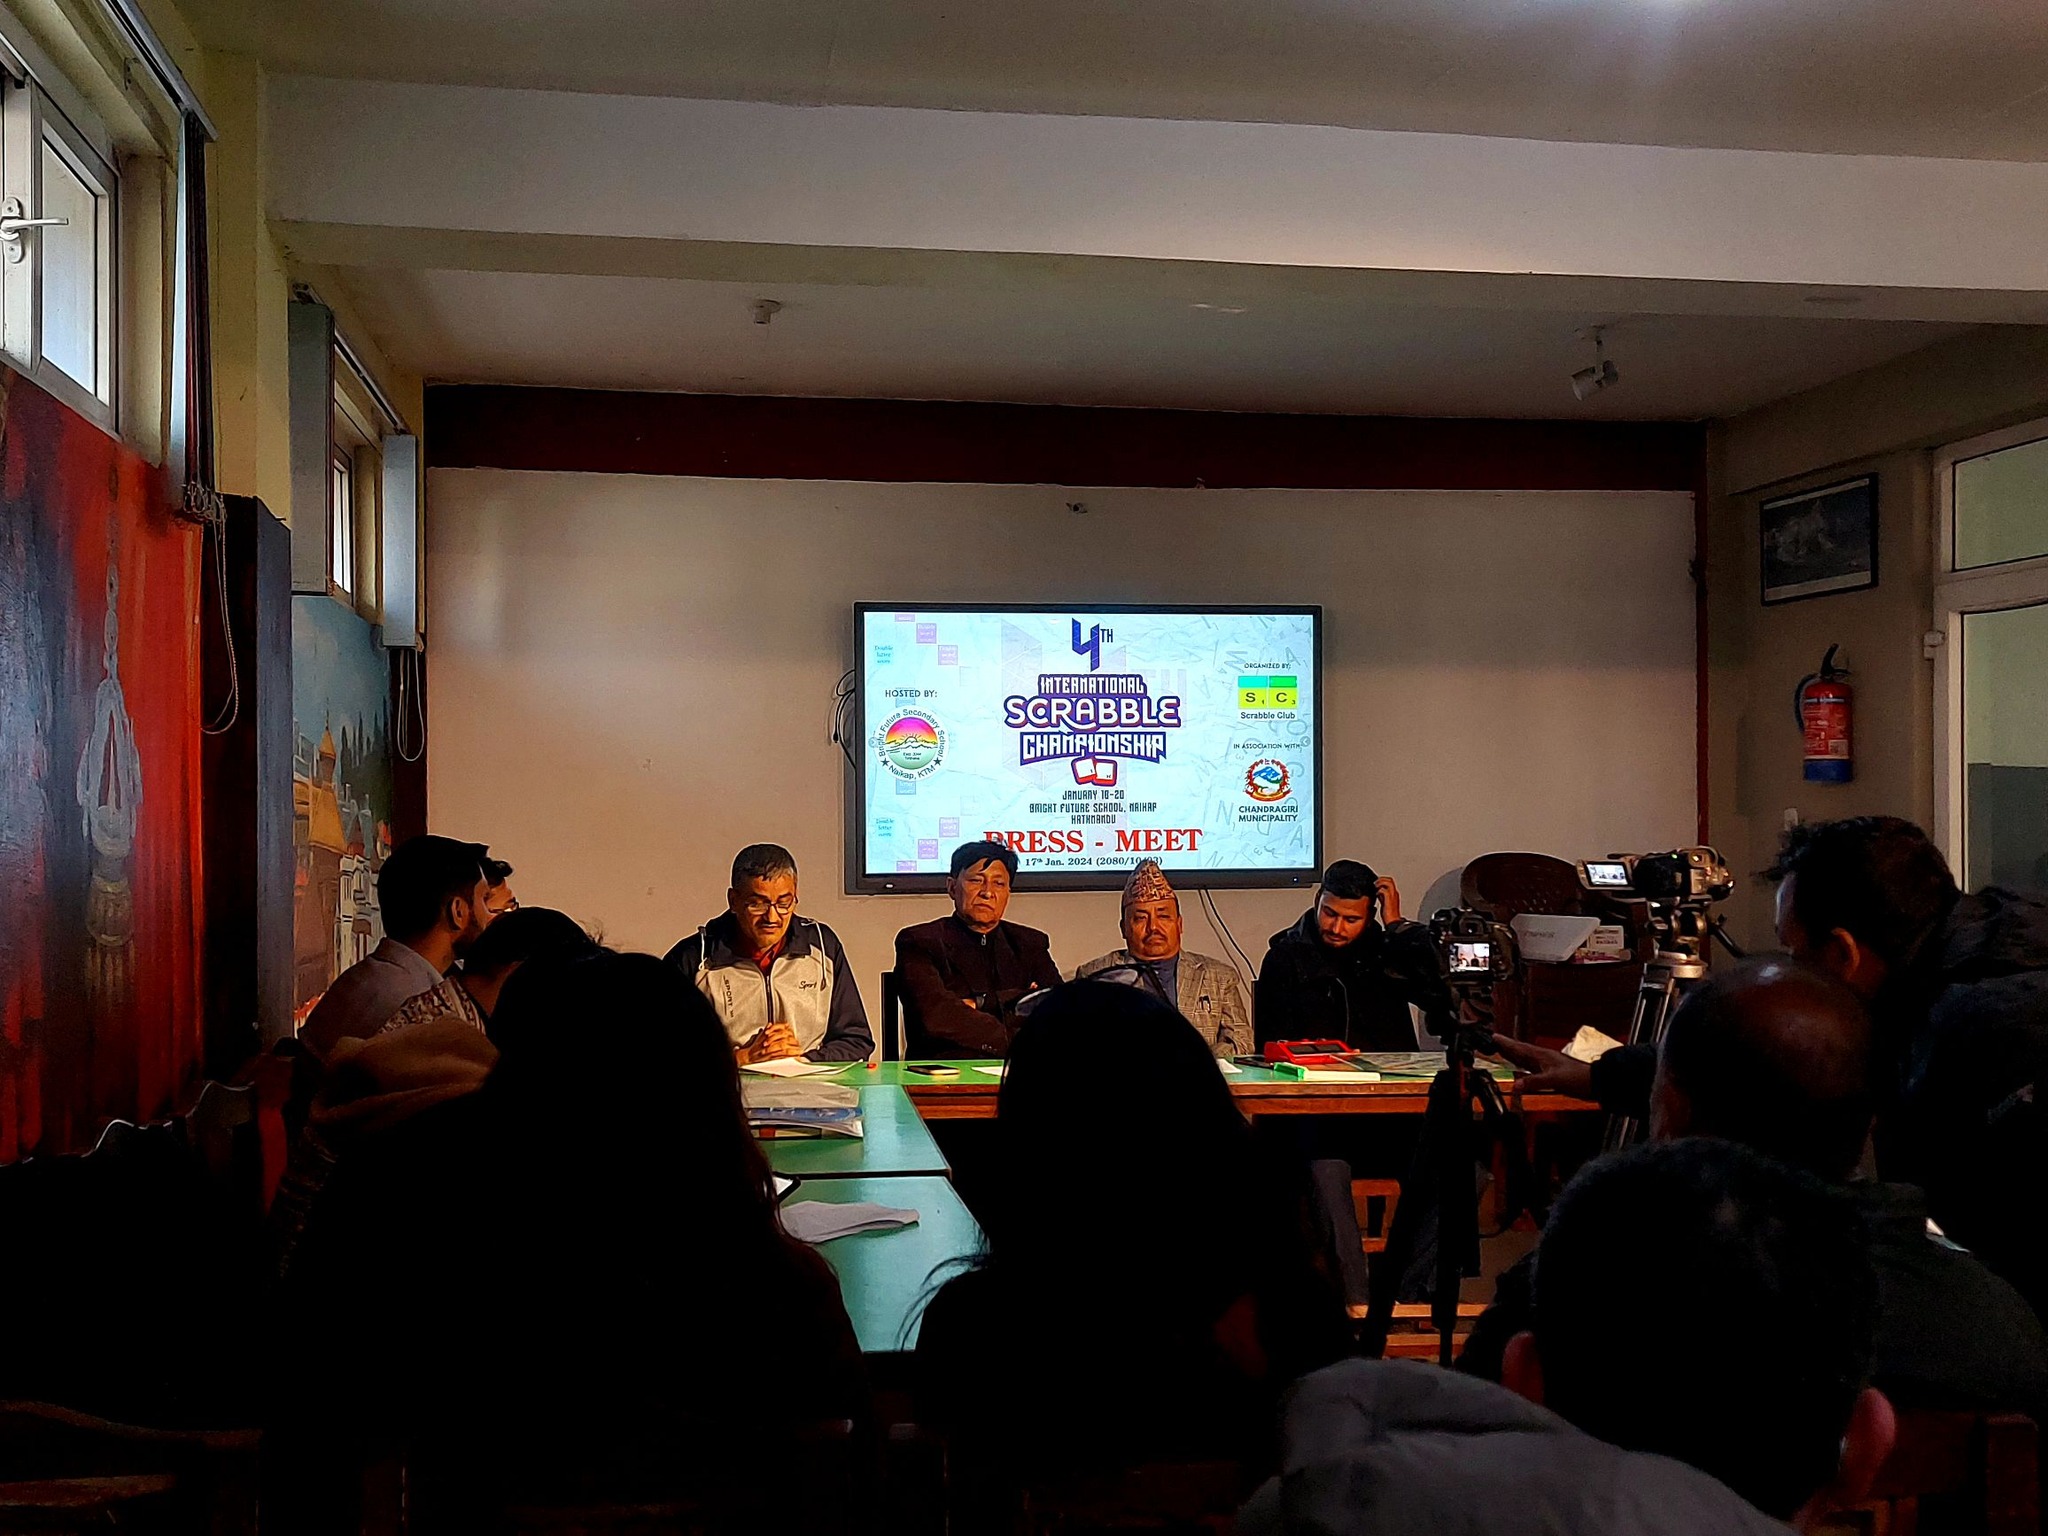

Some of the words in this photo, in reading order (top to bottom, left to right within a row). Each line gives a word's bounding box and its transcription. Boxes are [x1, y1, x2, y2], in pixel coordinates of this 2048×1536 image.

[1040, 676, 1145, 695] INTERNATIONAL
[885, 689, 921, 698] HOSTED
[924, 689, 938, 698] BY:
[1005, 697, 1181, 731] SCRABBLE
[1240, 711, 1275, 719] Scrabble
[1277, 711, 1296, 719] Club
[879, 712, 901, 733] Future
[902, 708, 940, 729] Secondary
[937, 729, 945, 758] School
[1021, 733, 1165, 762] CHAMPIONSHIP
[917, 763, 936, 778] KTM
[1062, 790, 1098, 800] JANUARY
[1029, 803, 1057, 813] BRIGHT
[1060, 803, 1090, 813] FUTURE
[1129, 802, 1158, 813] NAIKAP
[1238, 805, 1298, 813] CHANDRAGIRI
[1071, 814, 1116, 824] KATHMANDU
[1238, 814, 1299, 822] MUNICIPALITY
[983, 830, 1084, 853] PRESS
[1115, 828, 1203, 852] MEET
[1045, 857, 1065, 866] Jan.
[1068, 857, 1092, 866] 2024
[799, 980, 818, 991] Sport
